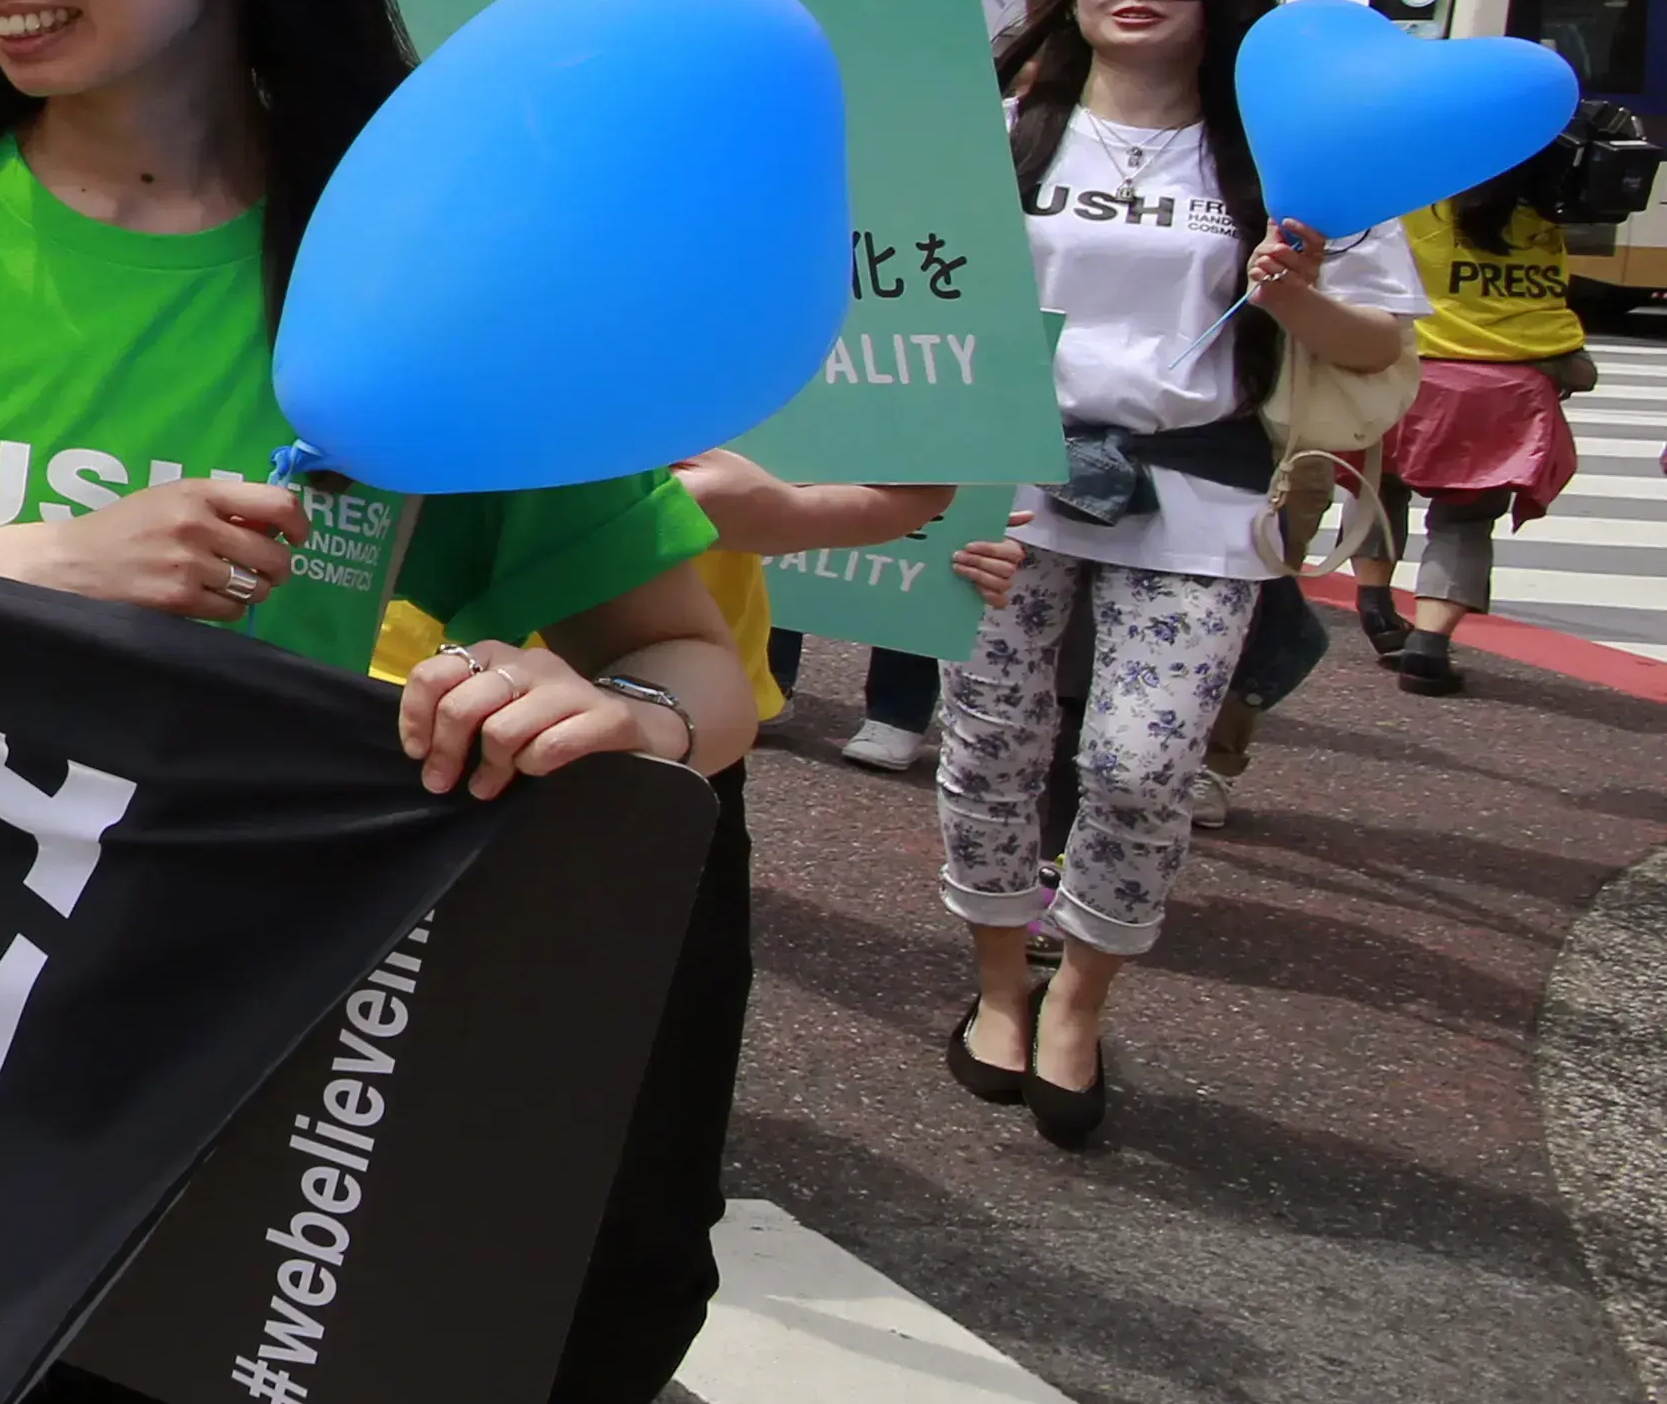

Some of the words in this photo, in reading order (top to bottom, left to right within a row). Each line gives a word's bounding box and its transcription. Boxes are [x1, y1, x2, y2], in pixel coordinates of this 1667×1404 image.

[1448, 261, 1568, 299] PRESS
[289, 528, 381, 566] ANDMADE
[762, 546, 927, 592] ALITY
